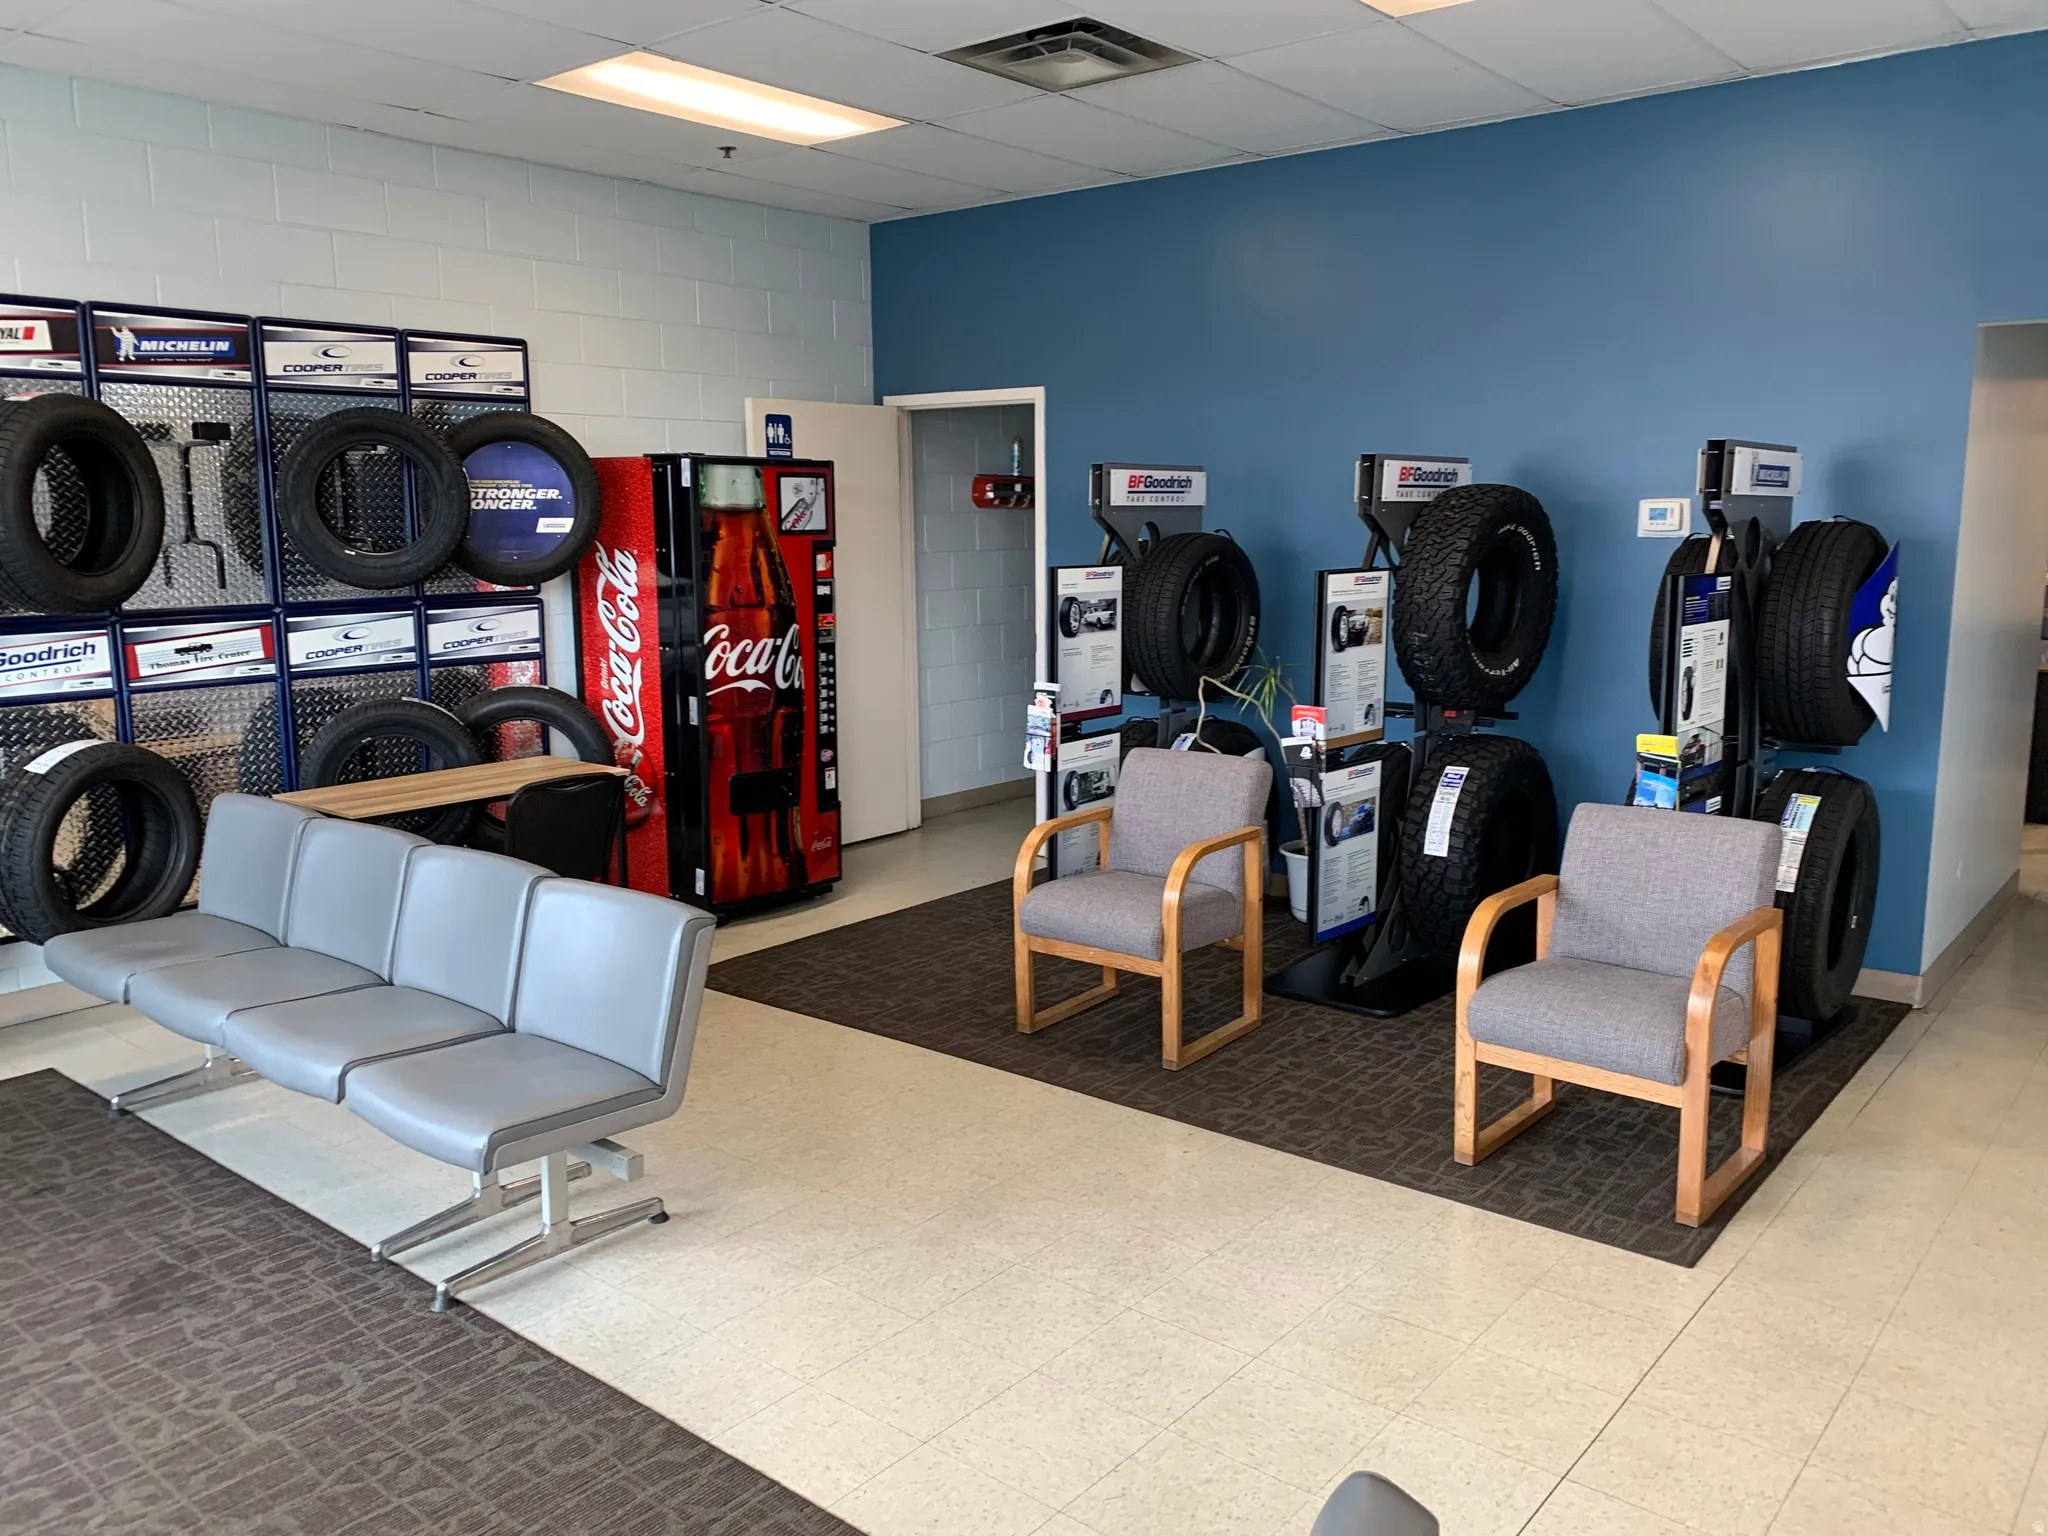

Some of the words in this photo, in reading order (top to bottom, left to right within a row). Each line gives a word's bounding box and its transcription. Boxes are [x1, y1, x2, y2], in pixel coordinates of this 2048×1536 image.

[140, 340, 230, 351] MICHELIN
[1128, 475, 1192, 489] BFGoodrich
[1398, 466, 1458, 483] BFGoodrich
[470, 488, 563, 499] STRONGER.
[471, 499, 537, 510] ONGER.
[595, 539, 645, 746] Coca-Cola
[148, 659, 191, 670] Thomas
[218, 649, 251, 660] Center
[5, 664, 82, 682] CONTROL
